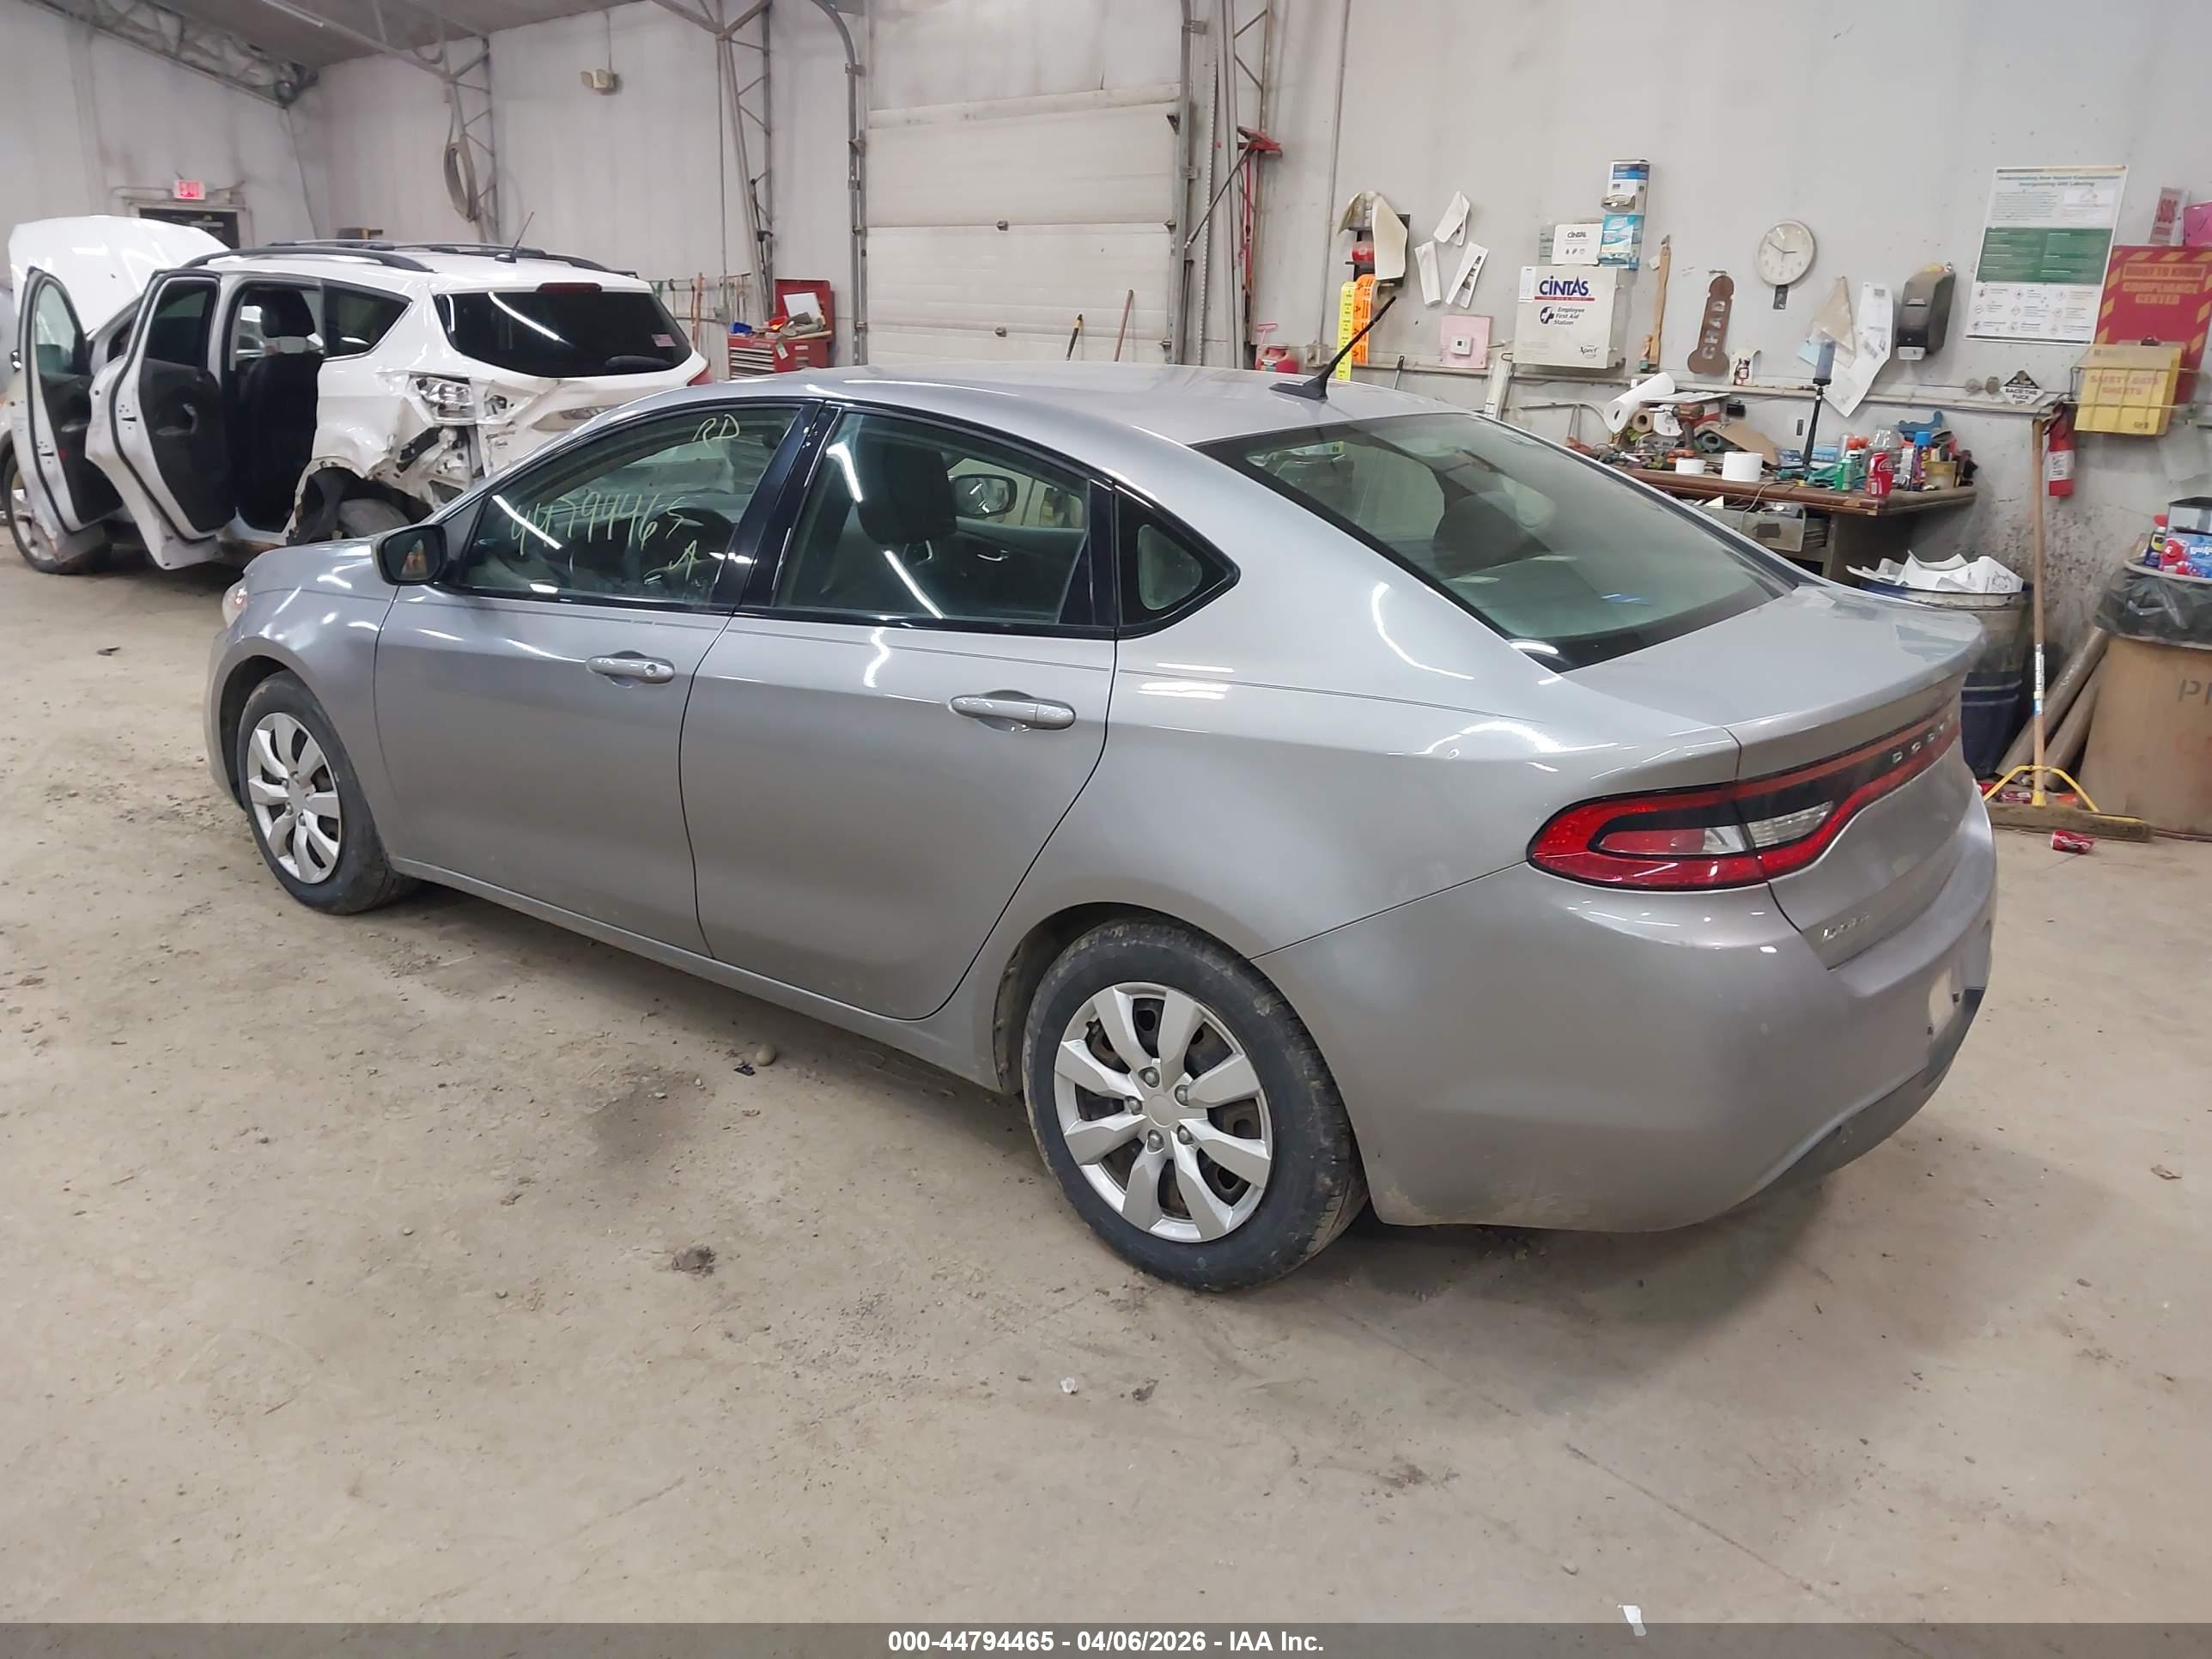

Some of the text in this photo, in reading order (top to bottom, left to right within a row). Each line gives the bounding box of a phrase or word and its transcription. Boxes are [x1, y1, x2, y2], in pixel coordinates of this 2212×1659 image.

[1539, 275, 1589, 296] CINTAS
[2135, 293, 2180, 305] CENTER
[1702, 300, 1726, 360] CHAD
[510, 491, 686, 557] 44794465
